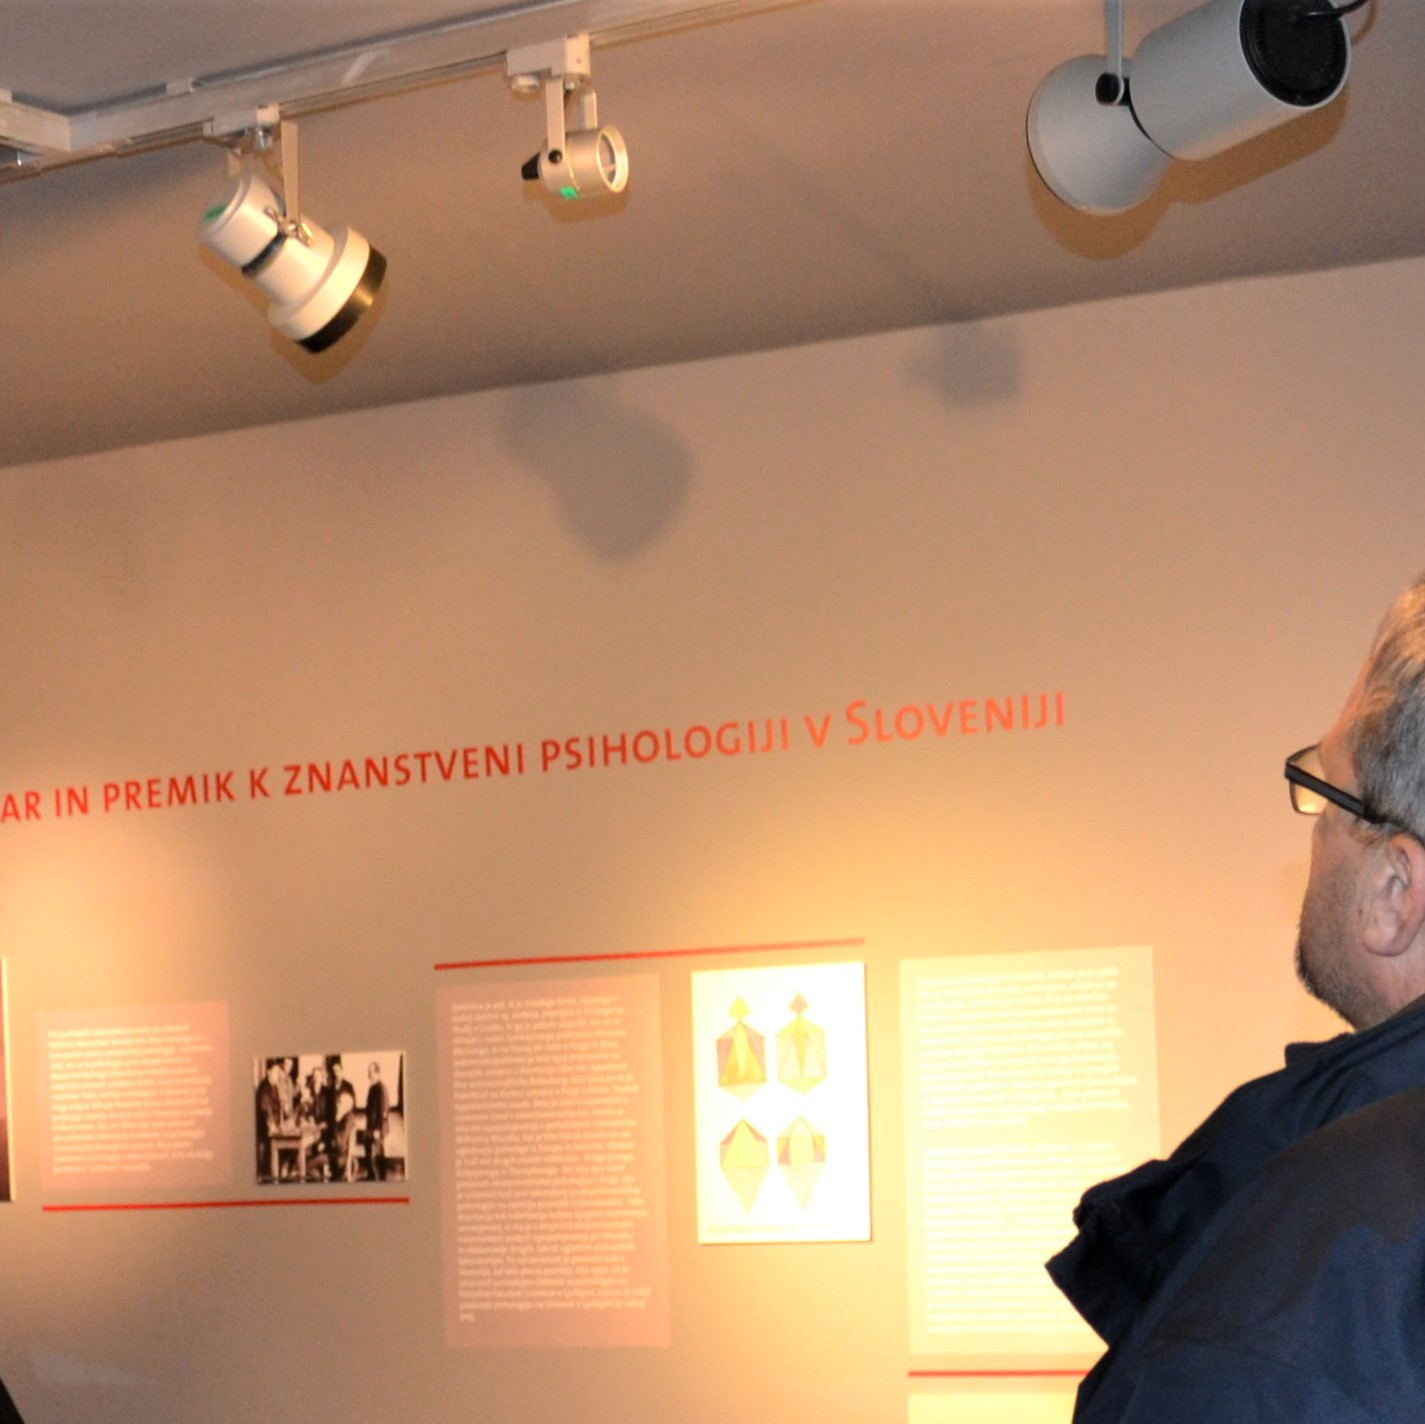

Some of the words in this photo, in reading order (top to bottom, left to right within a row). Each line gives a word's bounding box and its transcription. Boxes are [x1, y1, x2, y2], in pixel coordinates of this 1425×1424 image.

[53, 785, 92, 819] IN
[102, 770, 236, 814] PREMIK
[249, 767, 271, 800] K
[283, 741, 526, 797] ZNANSTVENI
[540, 716, 790, 773] PSIHOLOGIJI
[844, 691, 1066, 747] SLOVENIJI
